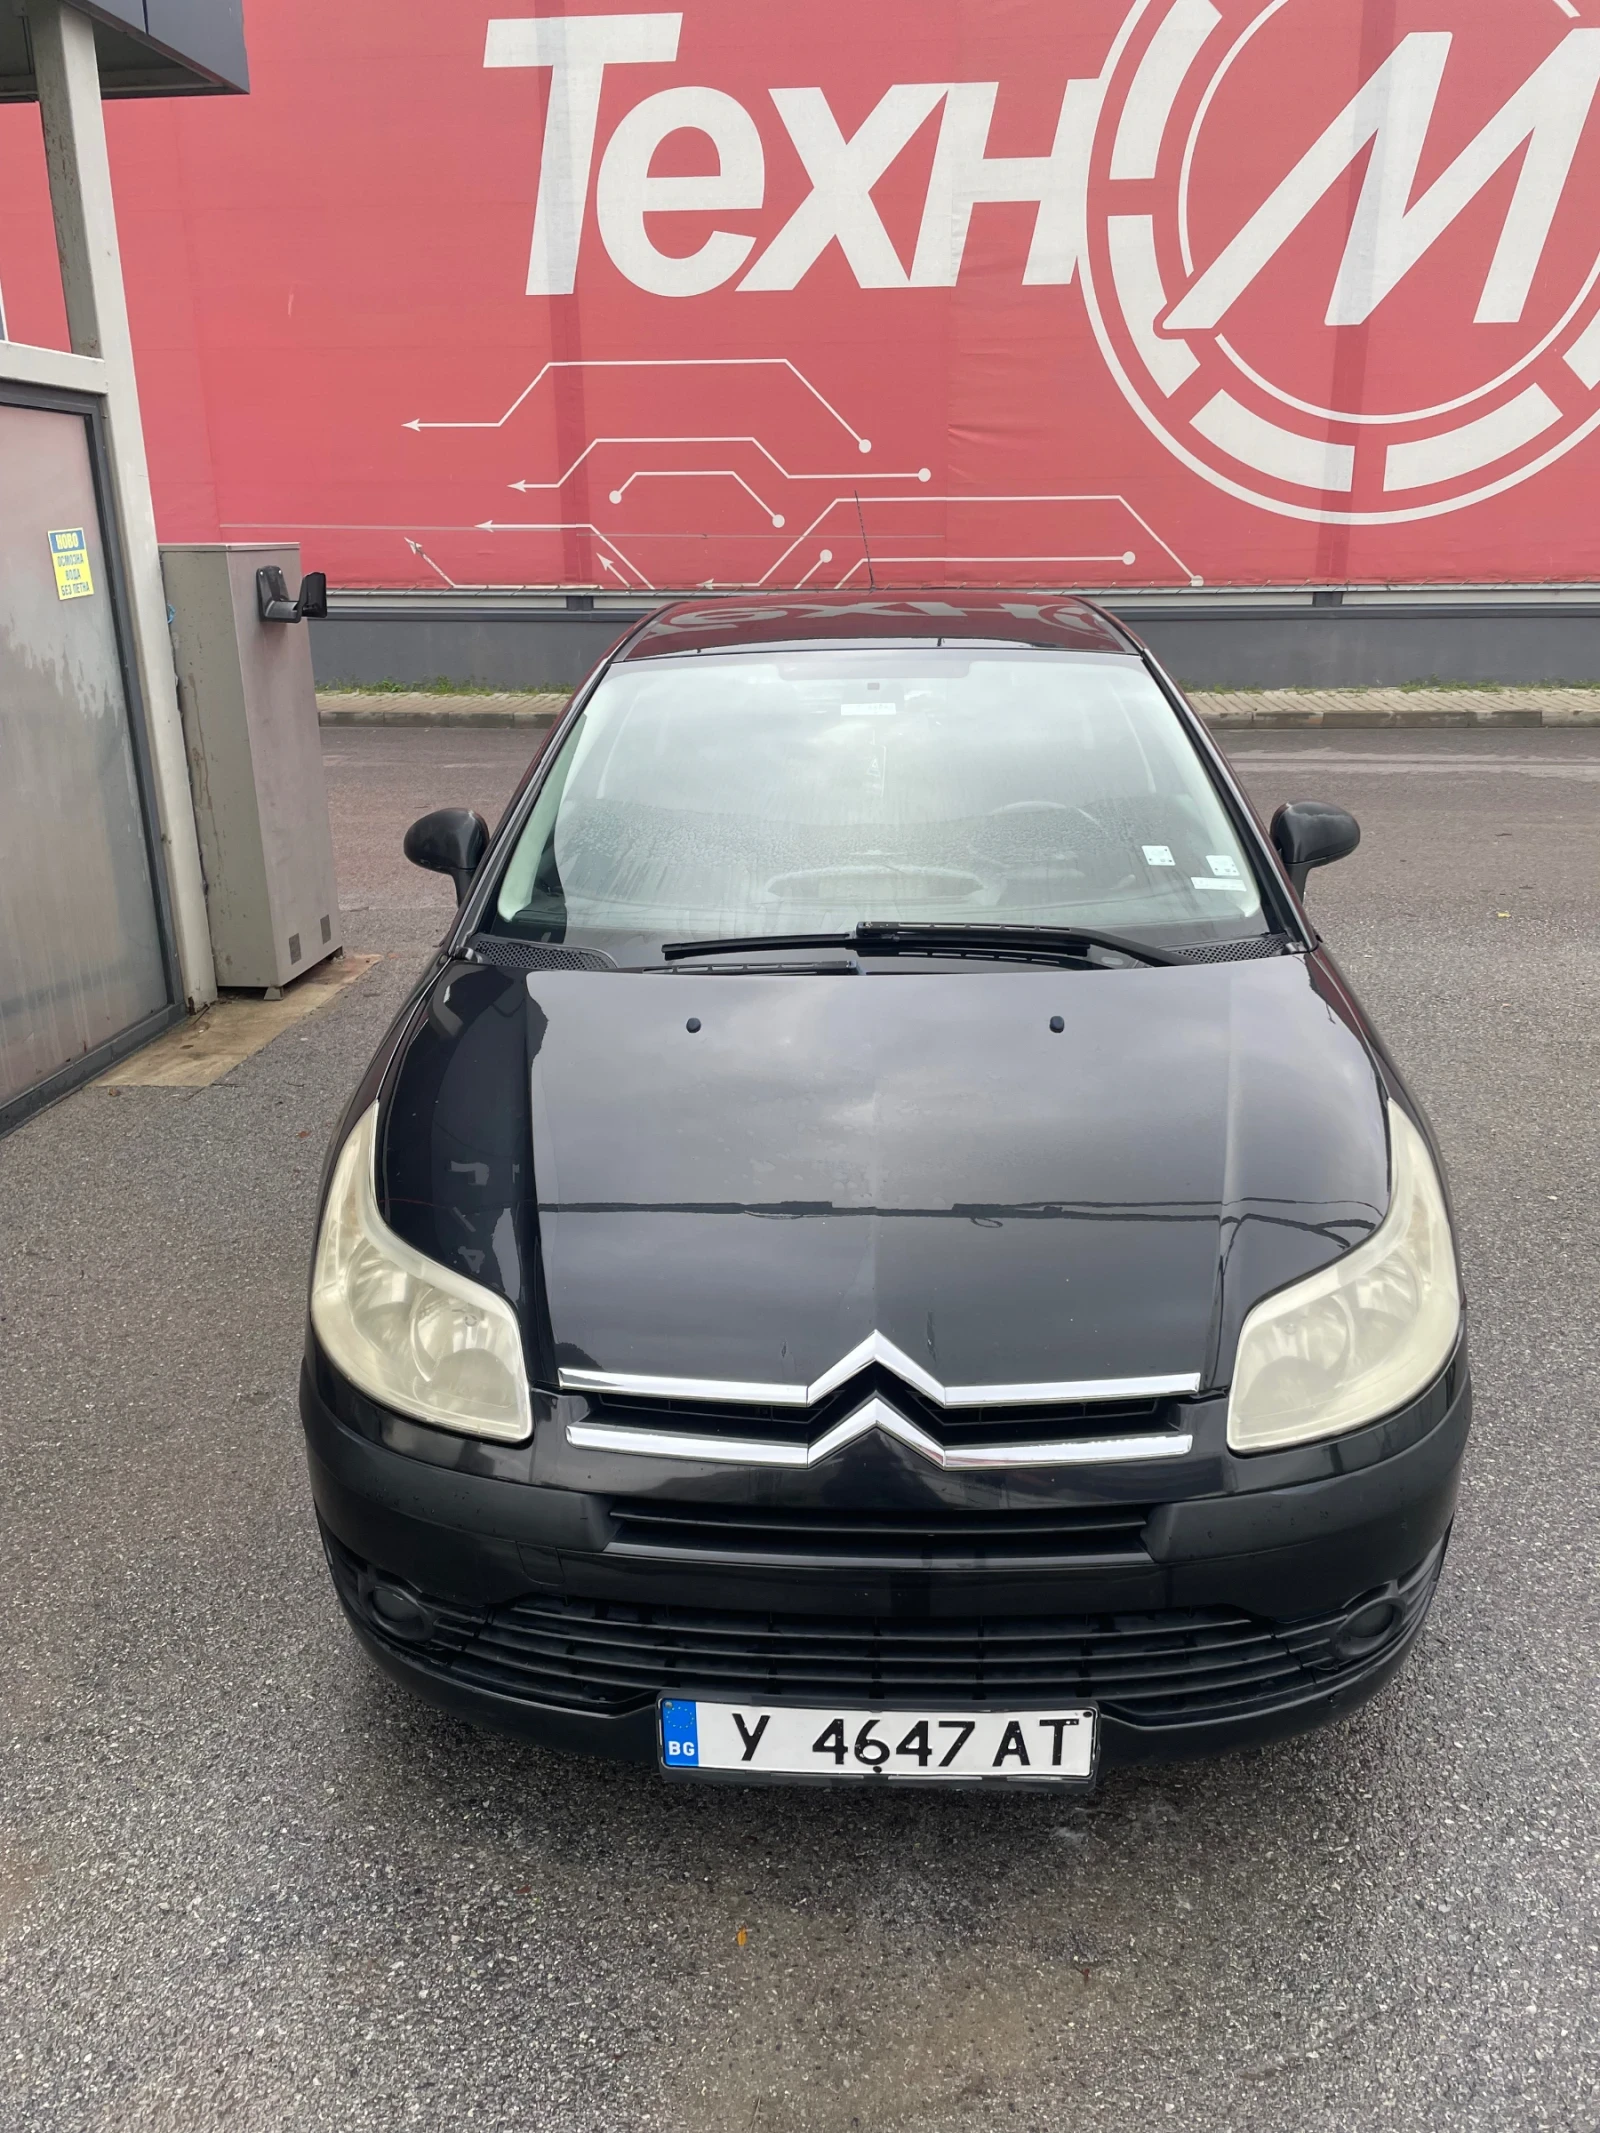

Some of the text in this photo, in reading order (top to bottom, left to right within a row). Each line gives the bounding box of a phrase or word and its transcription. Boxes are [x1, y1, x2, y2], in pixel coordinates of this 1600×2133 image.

[55, 532, 78, 549] НОВО
[57, 553, 83, 567] ОСМОЗНА
[65, 568, 80, 580] ВОДА
[61, 581, 90, 596] БЕЗ ПЕТНА
[668, 1740, 695, 1756] BG
[812, 1718, 976, 1767] 4647
